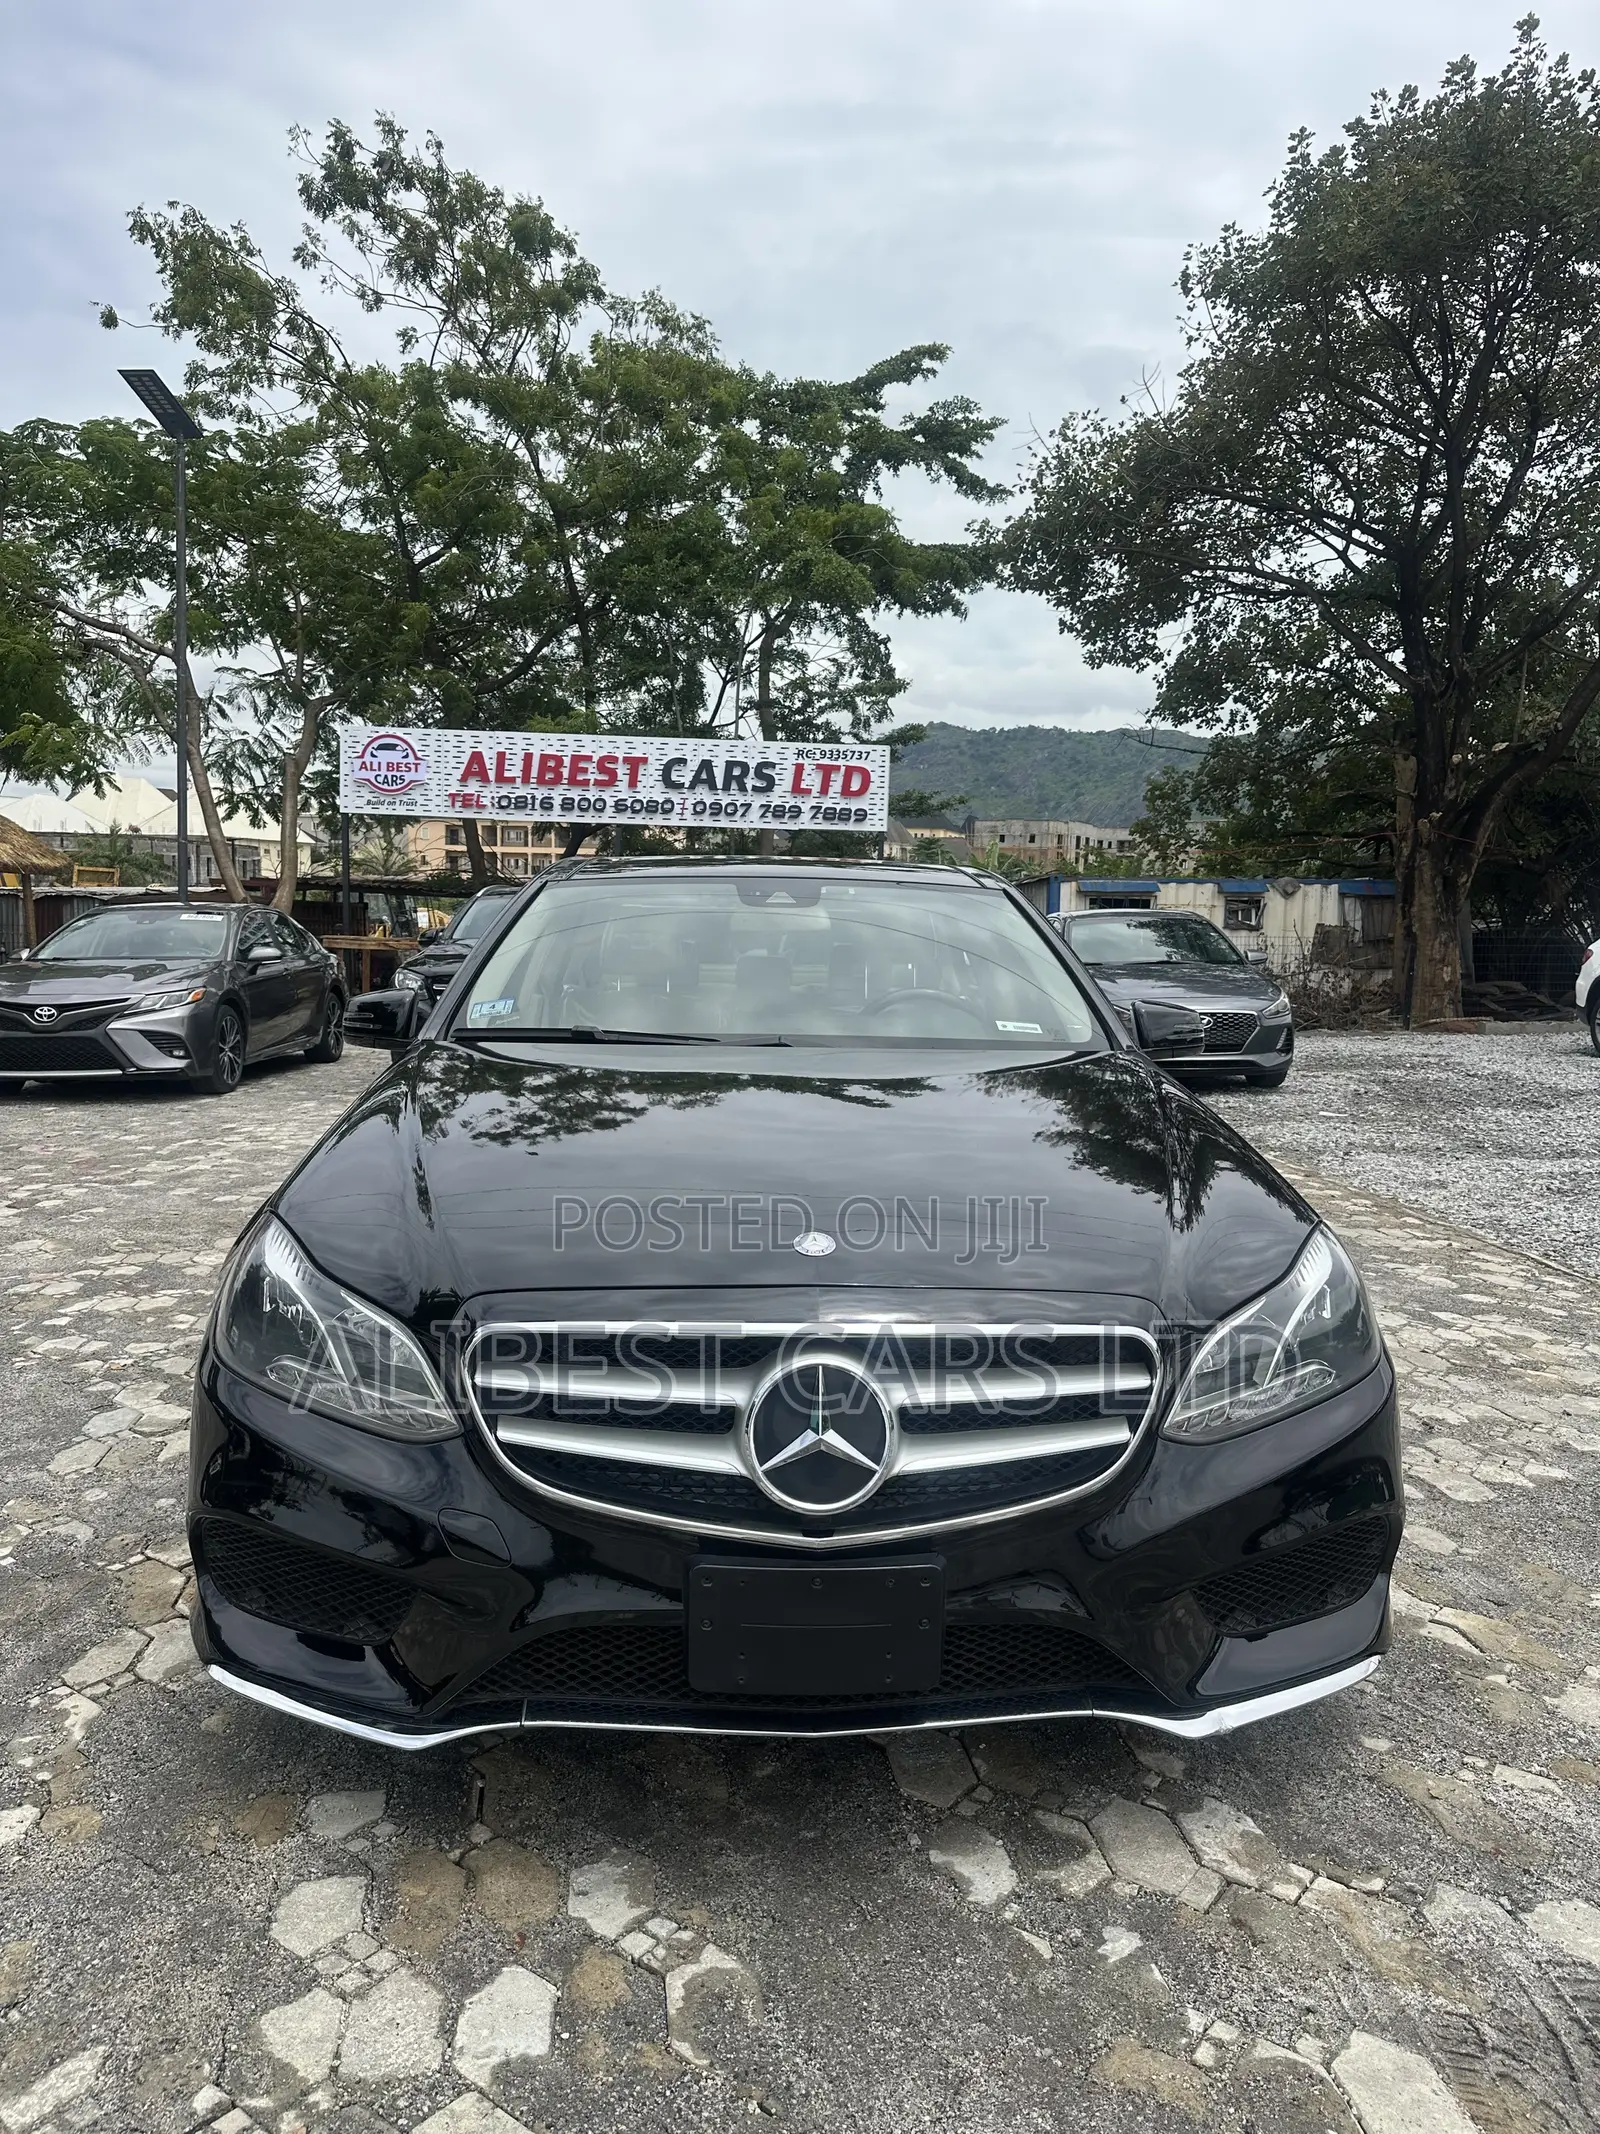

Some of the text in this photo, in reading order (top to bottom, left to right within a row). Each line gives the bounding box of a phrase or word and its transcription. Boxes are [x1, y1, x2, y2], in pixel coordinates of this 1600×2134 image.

[819, 750, 871, 761] 9335737
[359, 761, 421, 773] ALI BEST
[374, 774, 406, 787] CARS
[459, 751, 871, 798] ALIBEST CARS LTD
[366, 799, 385, 807] Build
[560, 797, 607, 812] 800
[614, 798, 675, 814] 6080
[693, 800, 752, 817] 0907
[759, 804, 802, 819] 789
[809, 805, 868, 822] 7889
